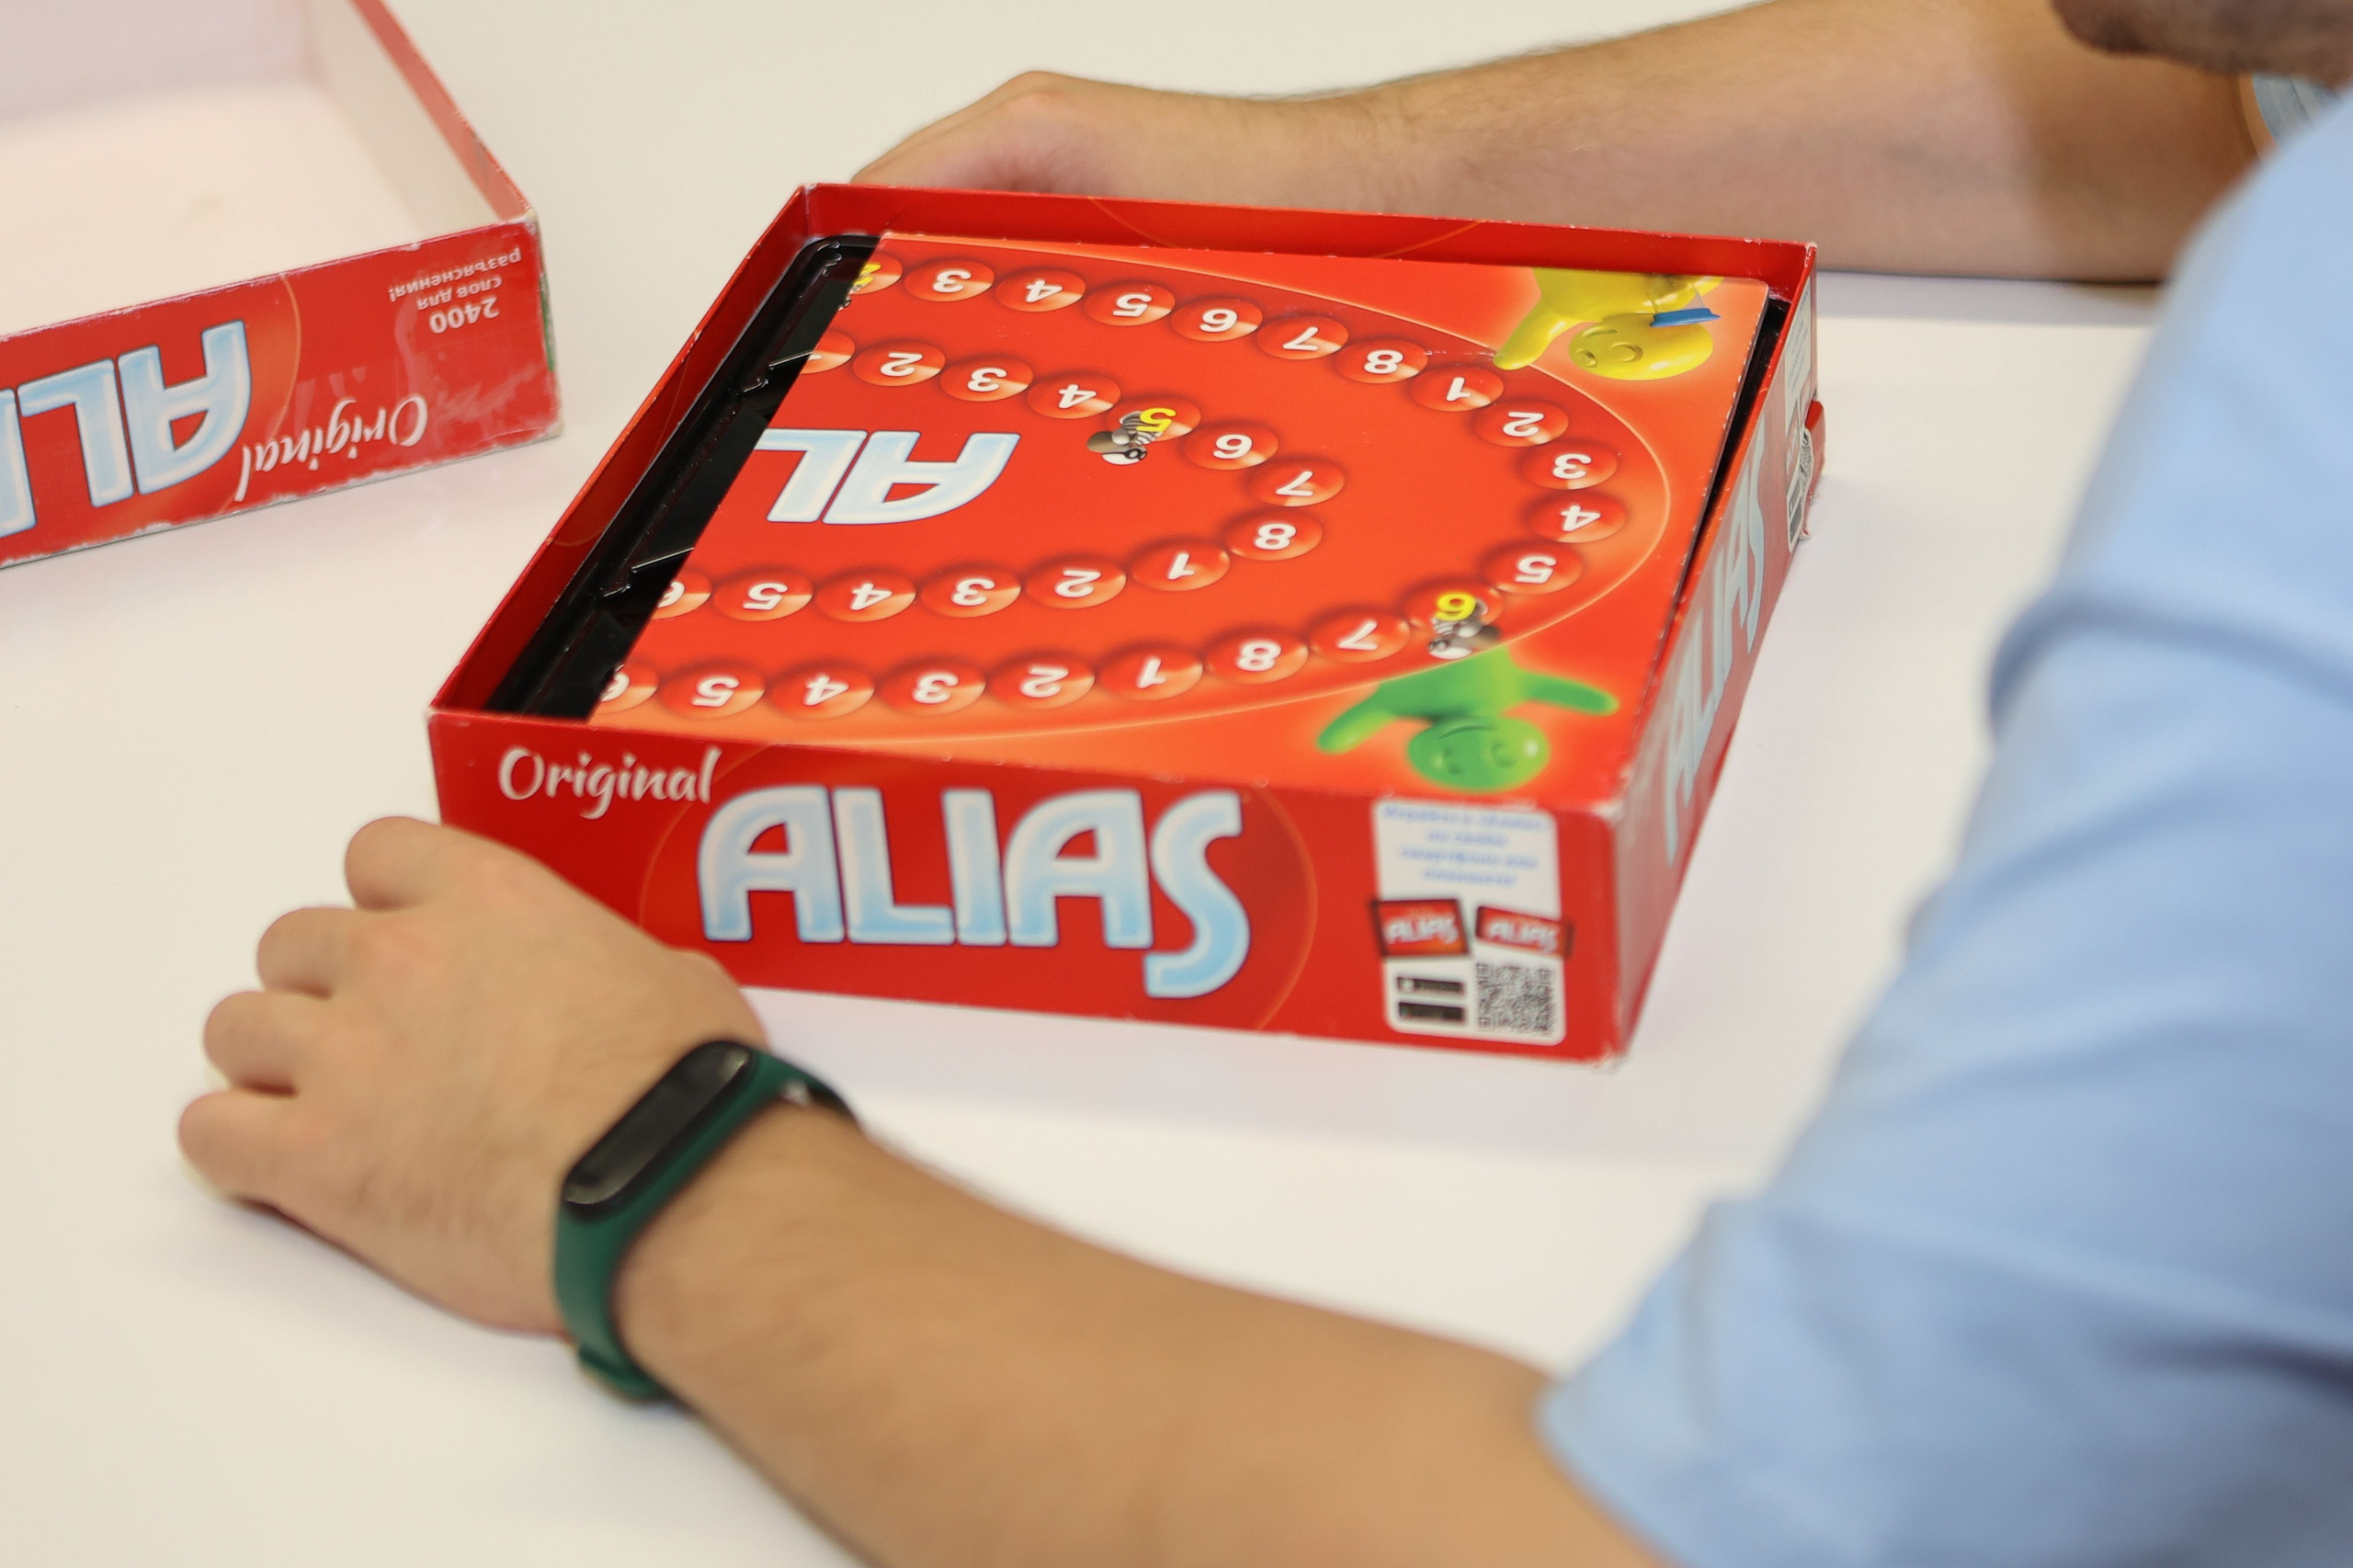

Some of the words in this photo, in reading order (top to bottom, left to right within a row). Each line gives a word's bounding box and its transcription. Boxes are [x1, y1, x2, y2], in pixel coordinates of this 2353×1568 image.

[387, 246, 522, 303] разъяснения!
[456, 277, 503, 299] слов
[932, 269, 972, 293] 3
[416, 288, 452, 311] для
[1026, 279, 1063, 303] 4
[1112, 293, 1153, 317] 5
[428, 296, 500, 335] 2400
[1199, 308, 1238, 333] 6
[1282, 326, 1319, 351] 7
[880, 352, 923, 377] 2
[1364, 349, 1404, 374] 8
[967, 368, 1007, 392] 3
[1446, 377, 1471, 402] 1
[1058, 384, 1097, 410] 4
[1138, 407, 1177, 433] 5
[1502, 411, 1545, 438] 2
[233, 392, 428, 503] Original
[1212, 434, 1253, 460] 6
[1552, 453, 1592, 480] 3
[1275, 471, 1313, 497] 7
[1561, 505, 1601, 532] 4
[1254, 522, 1297, 551] 8
[1167, 552, 1196, 580] 1
[1515, 554, 1557, 584] 5
[743, 582, 789, 610] 5
[850, 582, 892, 611] 4
[951, 577, 995, 607] 3
[1054, 569, 1101, 598] 2
[1436, 592, 1476, 620] 6
[1337, 619, 1379, 651] 7
[1236, 641, 1282, 672] 8
[1020, 665, 1069, 698] 2
[1137, 657, 1166, 688] 1
[692, 676, 740, 708] 5
[804, 675, 848, 706] 4
[913, 673, 959, 704] 3
[497, 744, 722, 820] Original
[697, 783, 1251, 999] ALIAS
